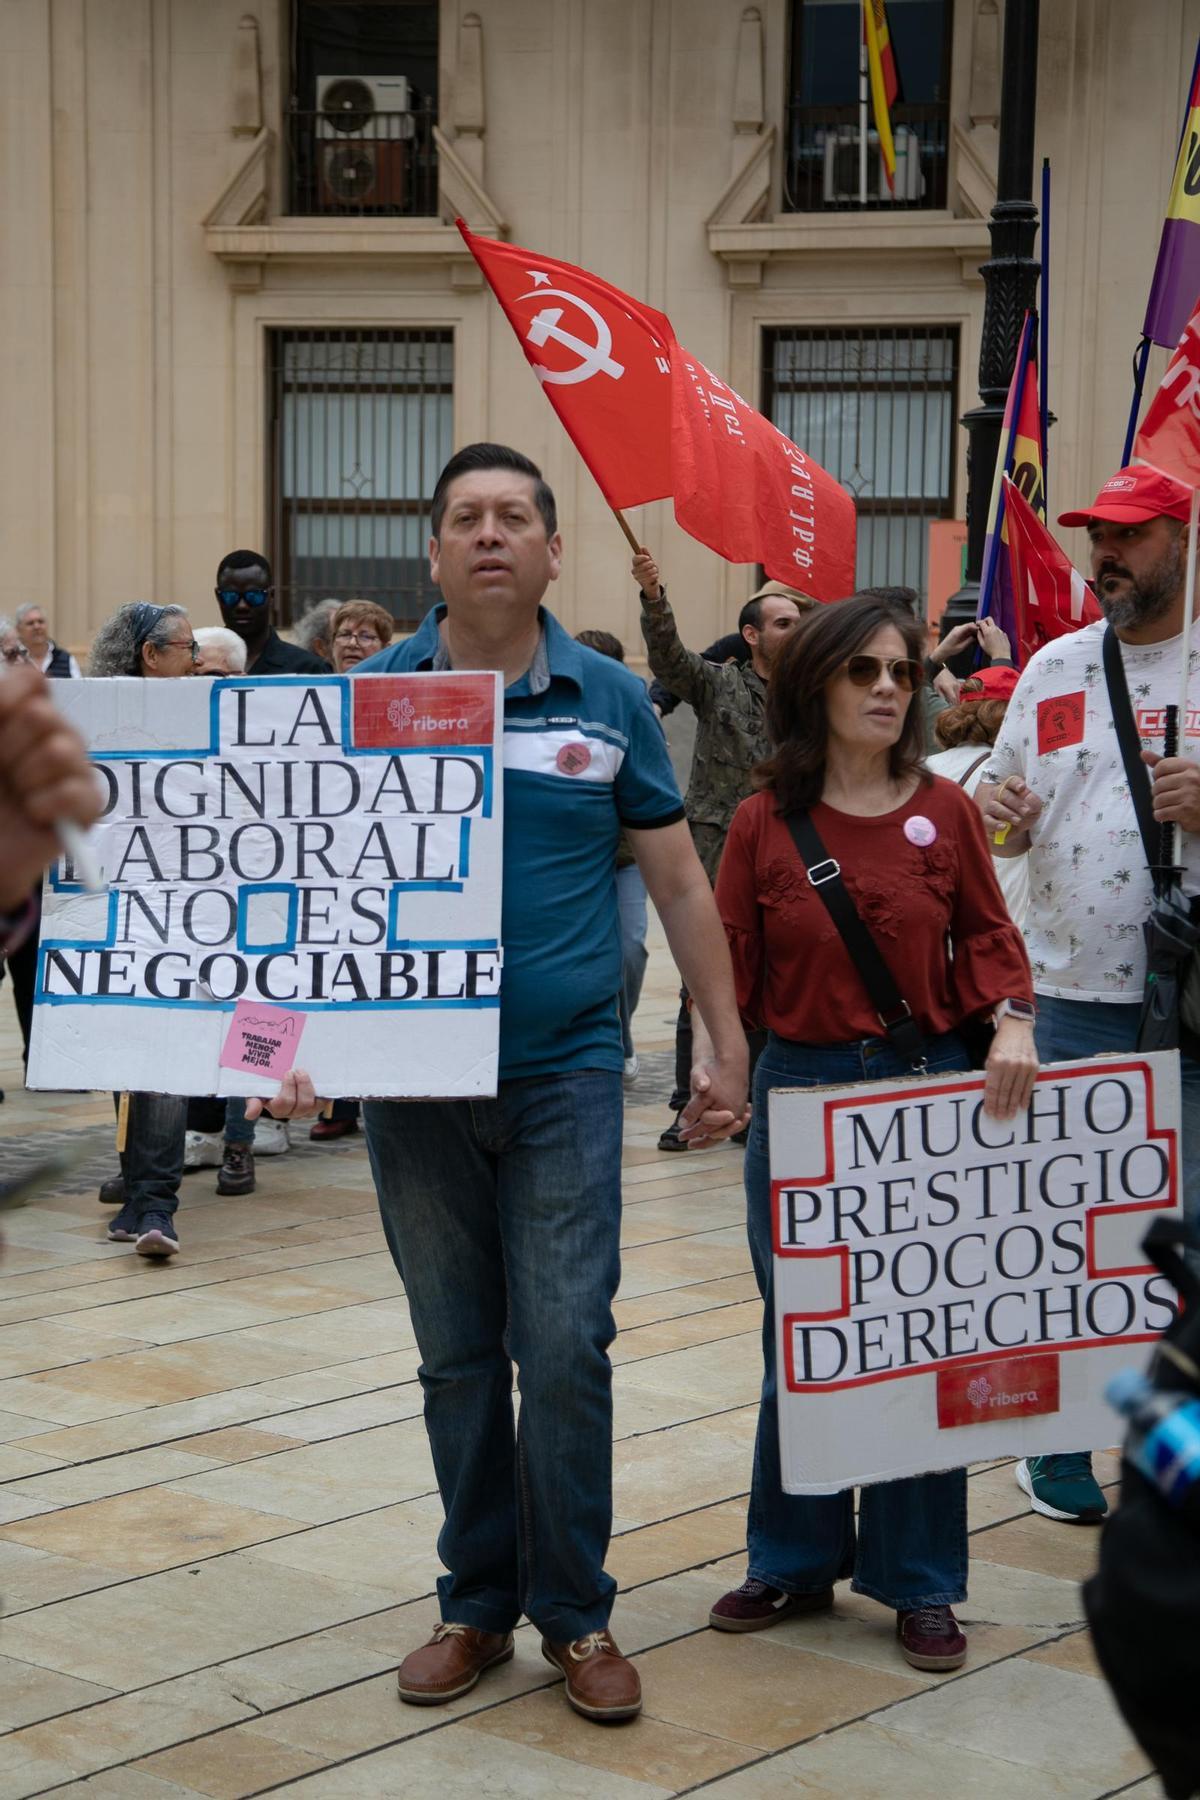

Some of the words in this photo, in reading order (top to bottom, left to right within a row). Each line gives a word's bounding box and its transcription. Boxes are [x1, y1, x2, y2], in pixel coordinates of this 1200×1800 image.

[231, 688, 341, 747] LA
[413, 716, 469, 731] ribera
[118, 889, 238, 947] NO
[298, 887, 387, 946] ES
[42, 949, 500, 1001] NEGOCIABLE
[846, 1079, 1134, 1170] MUCHO
[780, 1144, 1170, 1246] PRESTIGIO
[850, 1219, 1085, 1307] POCOS
[795, 1276, 1179, 1383] DERECHOS
[989, 1390, 1039, 1408] ribera
